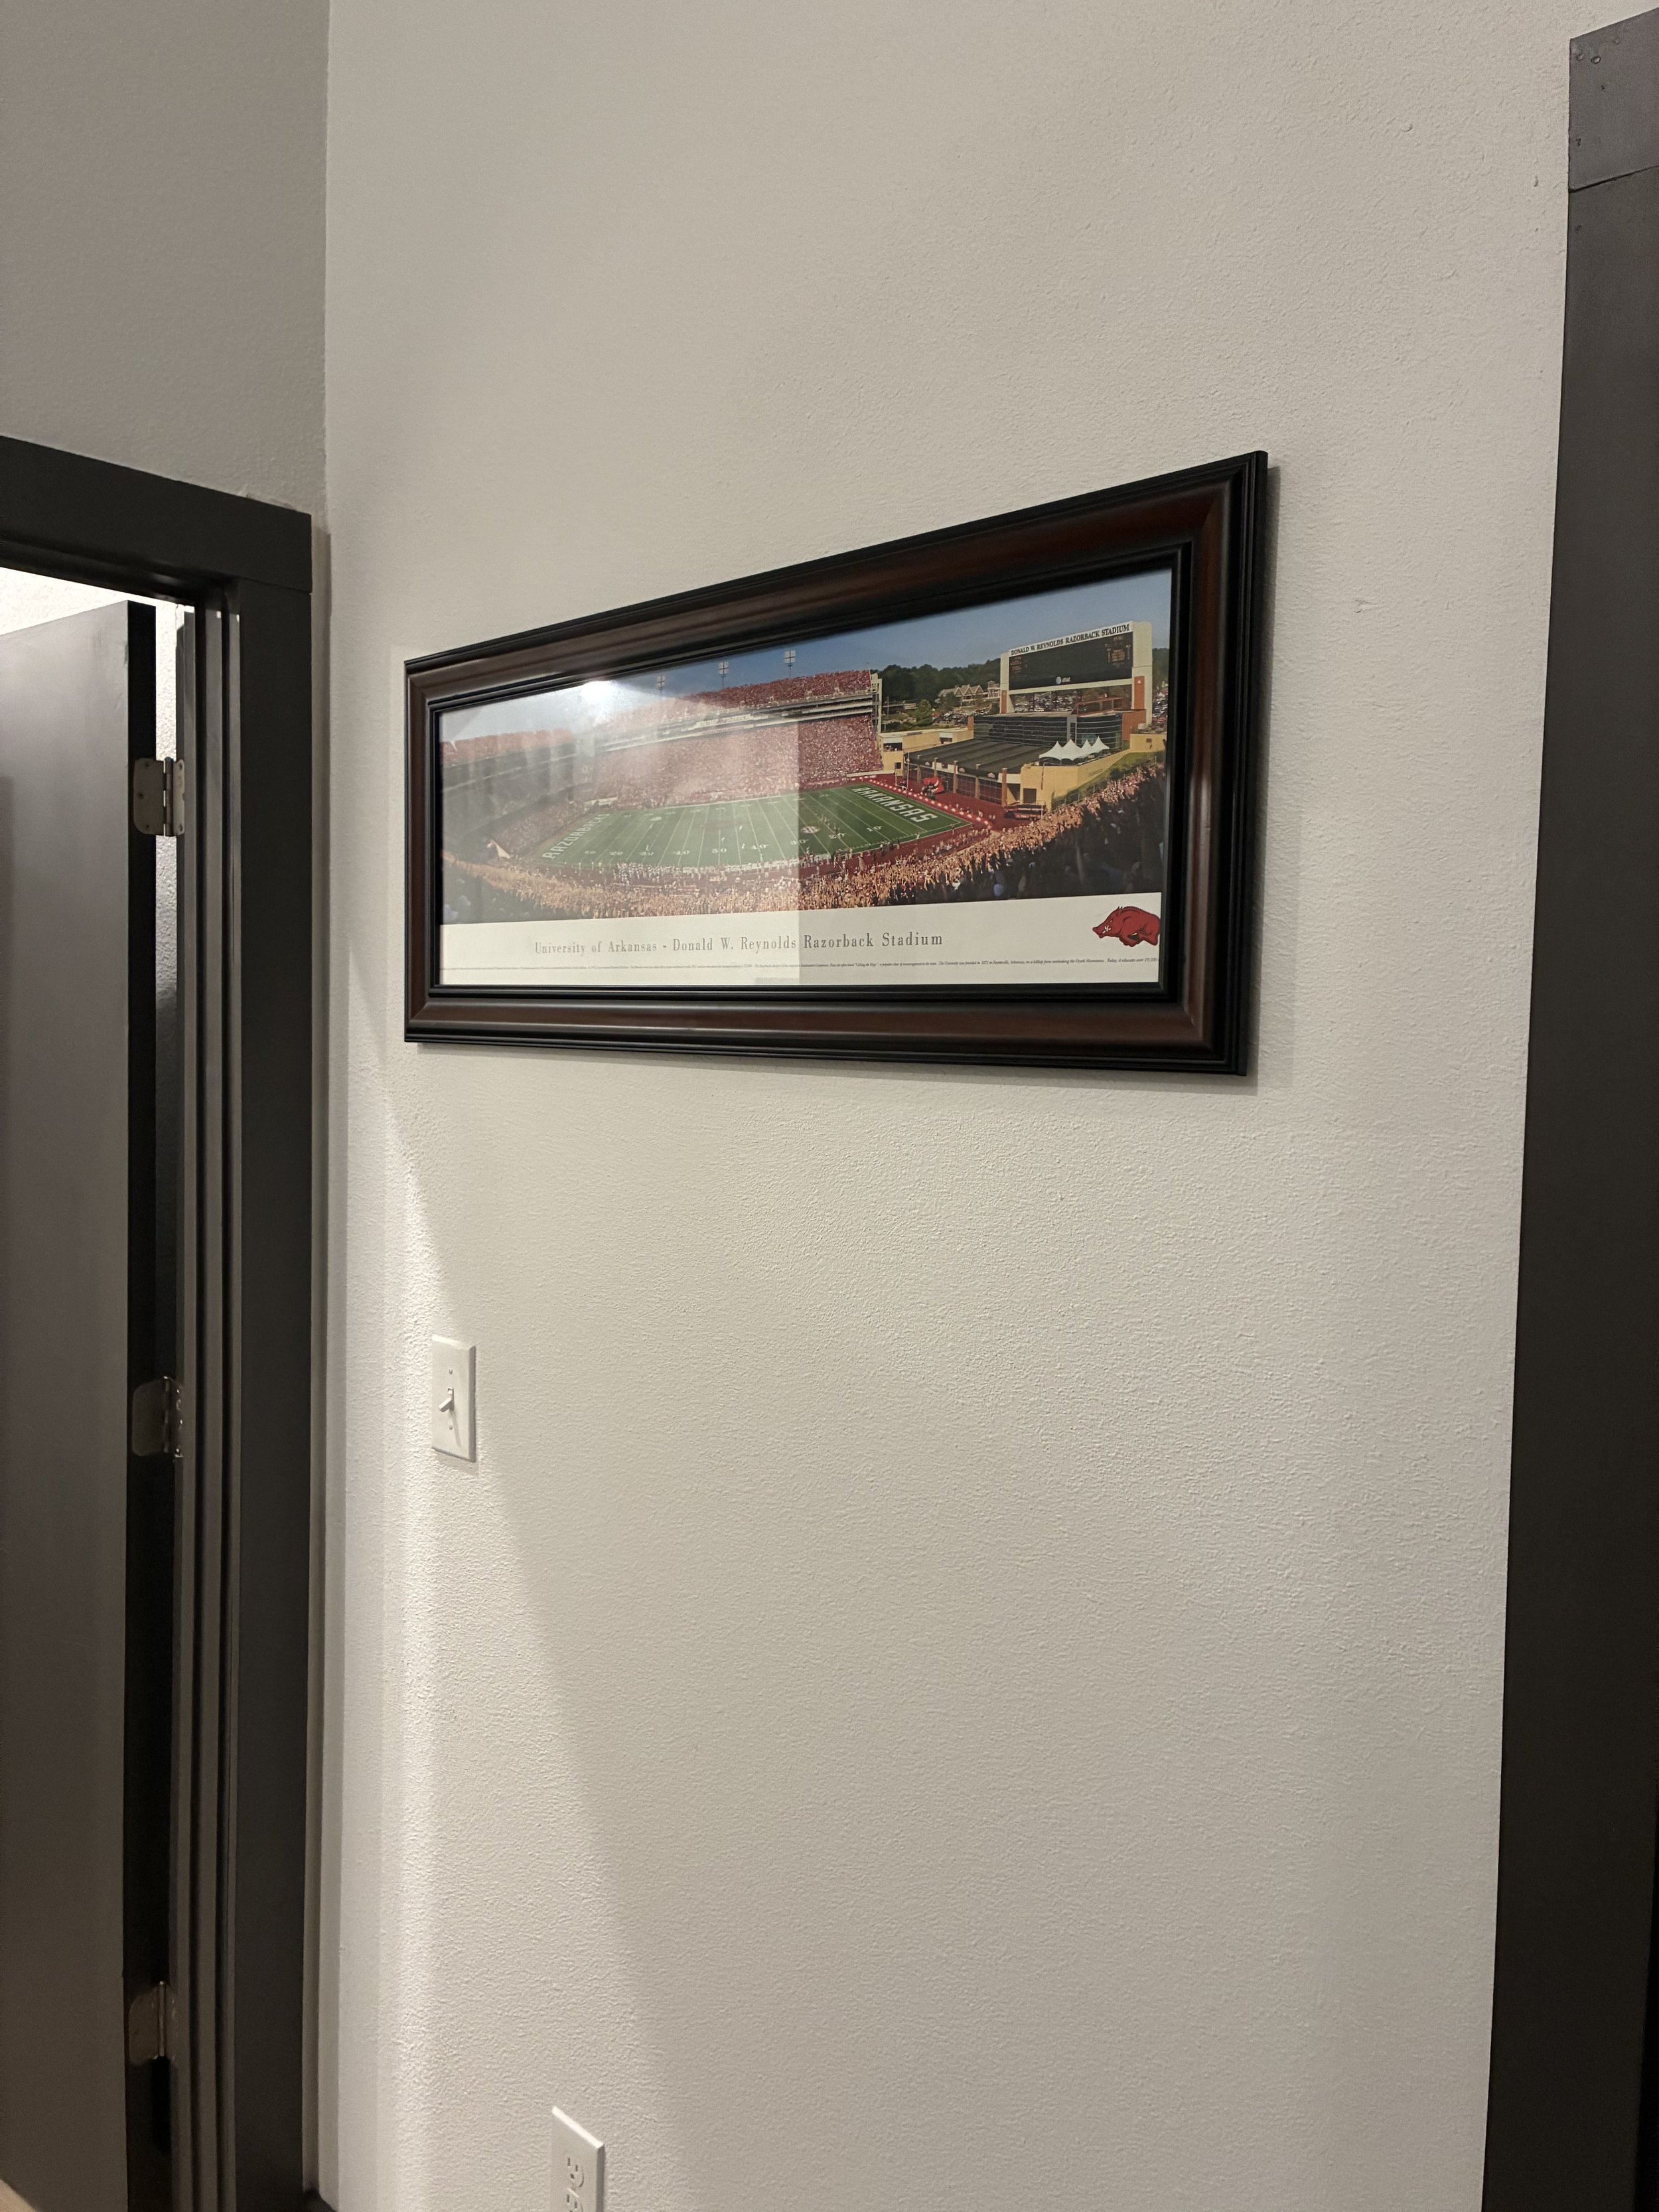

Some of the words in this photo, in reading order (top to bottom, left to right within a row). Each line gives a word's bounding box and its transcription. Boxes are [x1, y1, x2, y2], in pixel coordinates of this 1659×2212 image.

[1011, 646, 1029, 656] DONALD
[1037, 638, 1064, 650] REYNOLDS
[1065, 630, 1100, 644] RAZORBACK
[1102, 624, 1130, 636] STADIUM
[851, 786, 938, 823] ARKANSAS
[535, 941, 585, 956] University
[591, 940, 603, 953] of
[608, 936, 658, 952] Arkansas
[672, 937, 713, 951] Donald
[721, 936, 734, 950] W.
[741, 935, 797, 954] Reynolds
[804, 932, 874, 949] Razorback
[881, 931, 943, 947] Stadium
